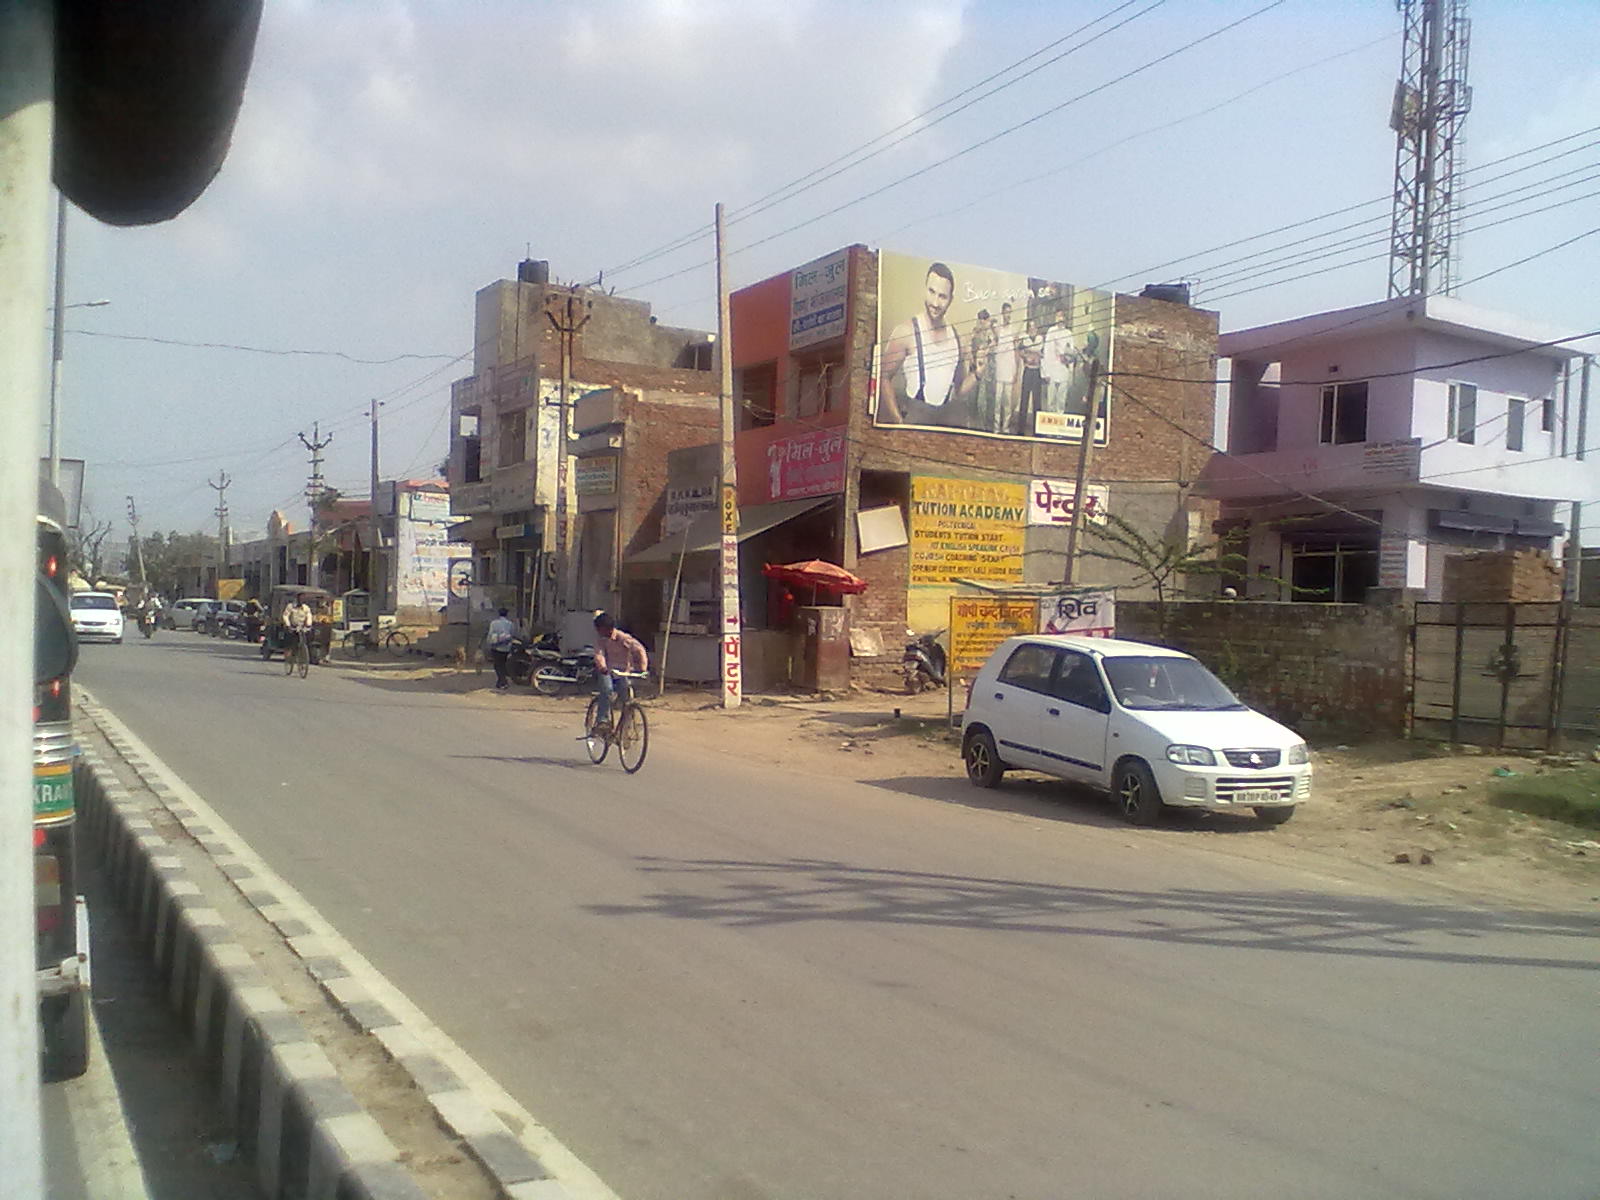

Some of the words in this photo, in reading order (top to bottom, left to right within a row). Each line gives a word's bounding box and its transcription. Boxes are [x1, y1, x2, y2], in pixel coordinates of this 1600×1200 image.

[913, 501, 956, 517] TUTION
[960, 504, 1024, 521] ACADEMY
[914, 530, 951, 539] STUDENTS
[1058, 597, 1097, 620] शिव
[724, 636, 740, 697] पेंटर
